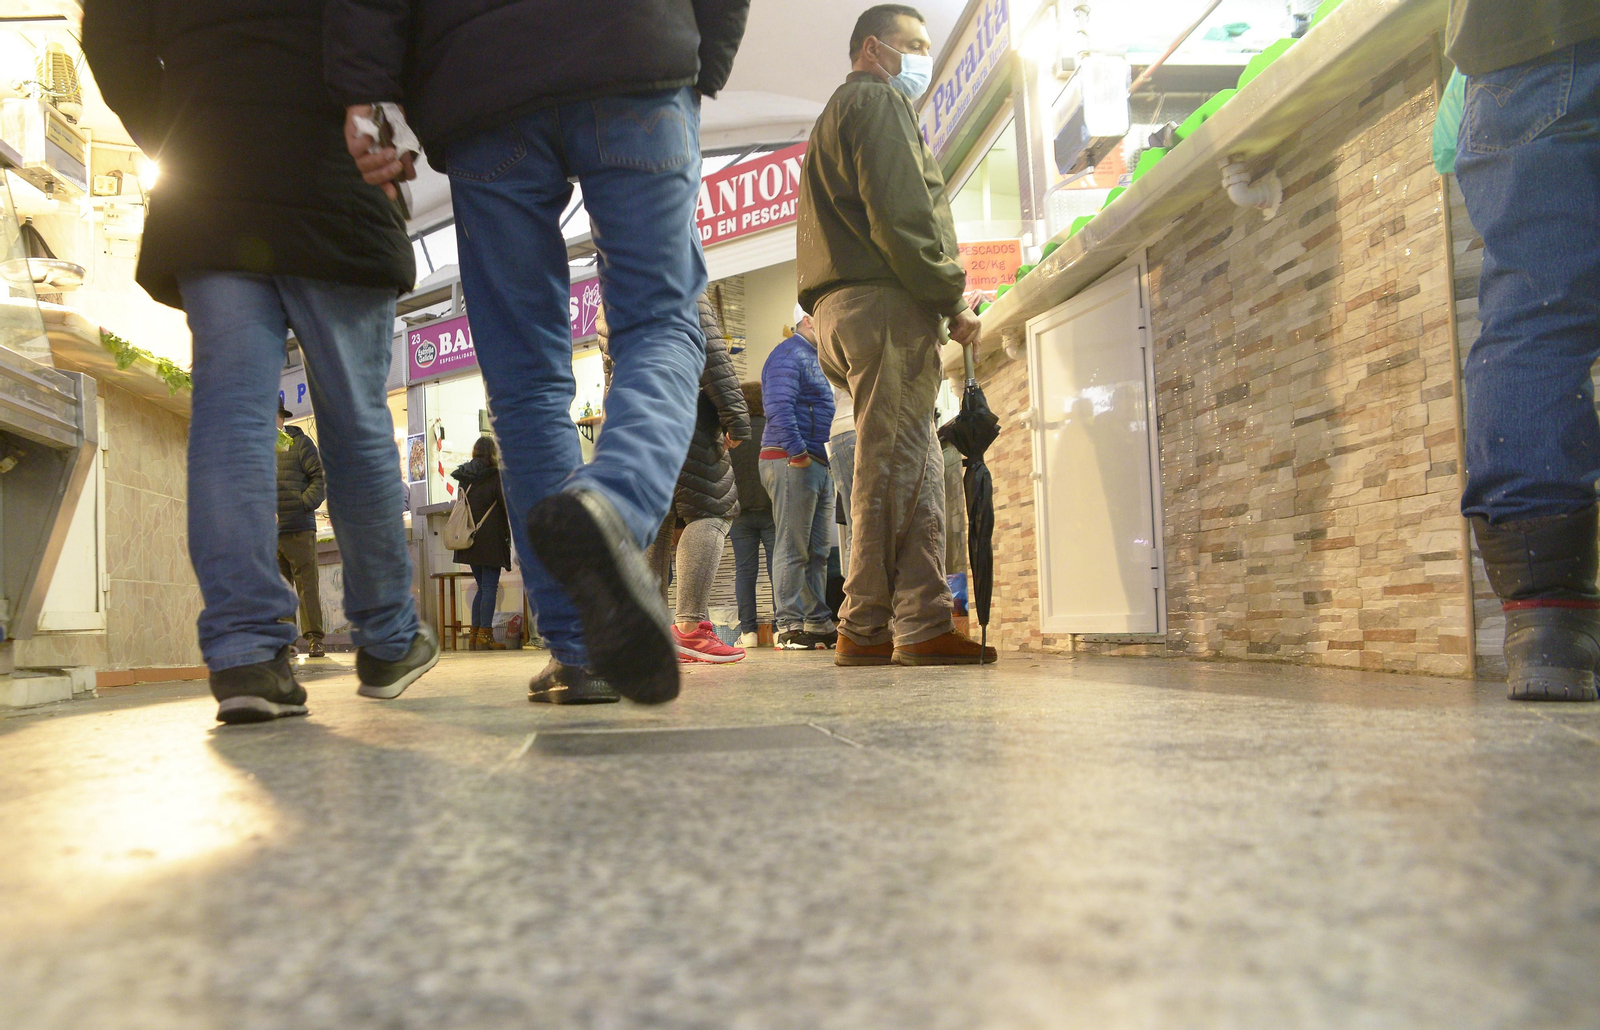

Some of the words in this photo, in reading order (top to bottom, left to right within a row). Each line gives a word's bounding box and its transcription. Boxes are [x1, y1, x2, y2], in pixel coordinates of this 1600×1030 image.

[717, 216, 737, 237] EN
[742, 198, 799, 229] PESCAI
[958, 244, 1016, 256] PESCADOS
[411, 333, 421, 345] 23
